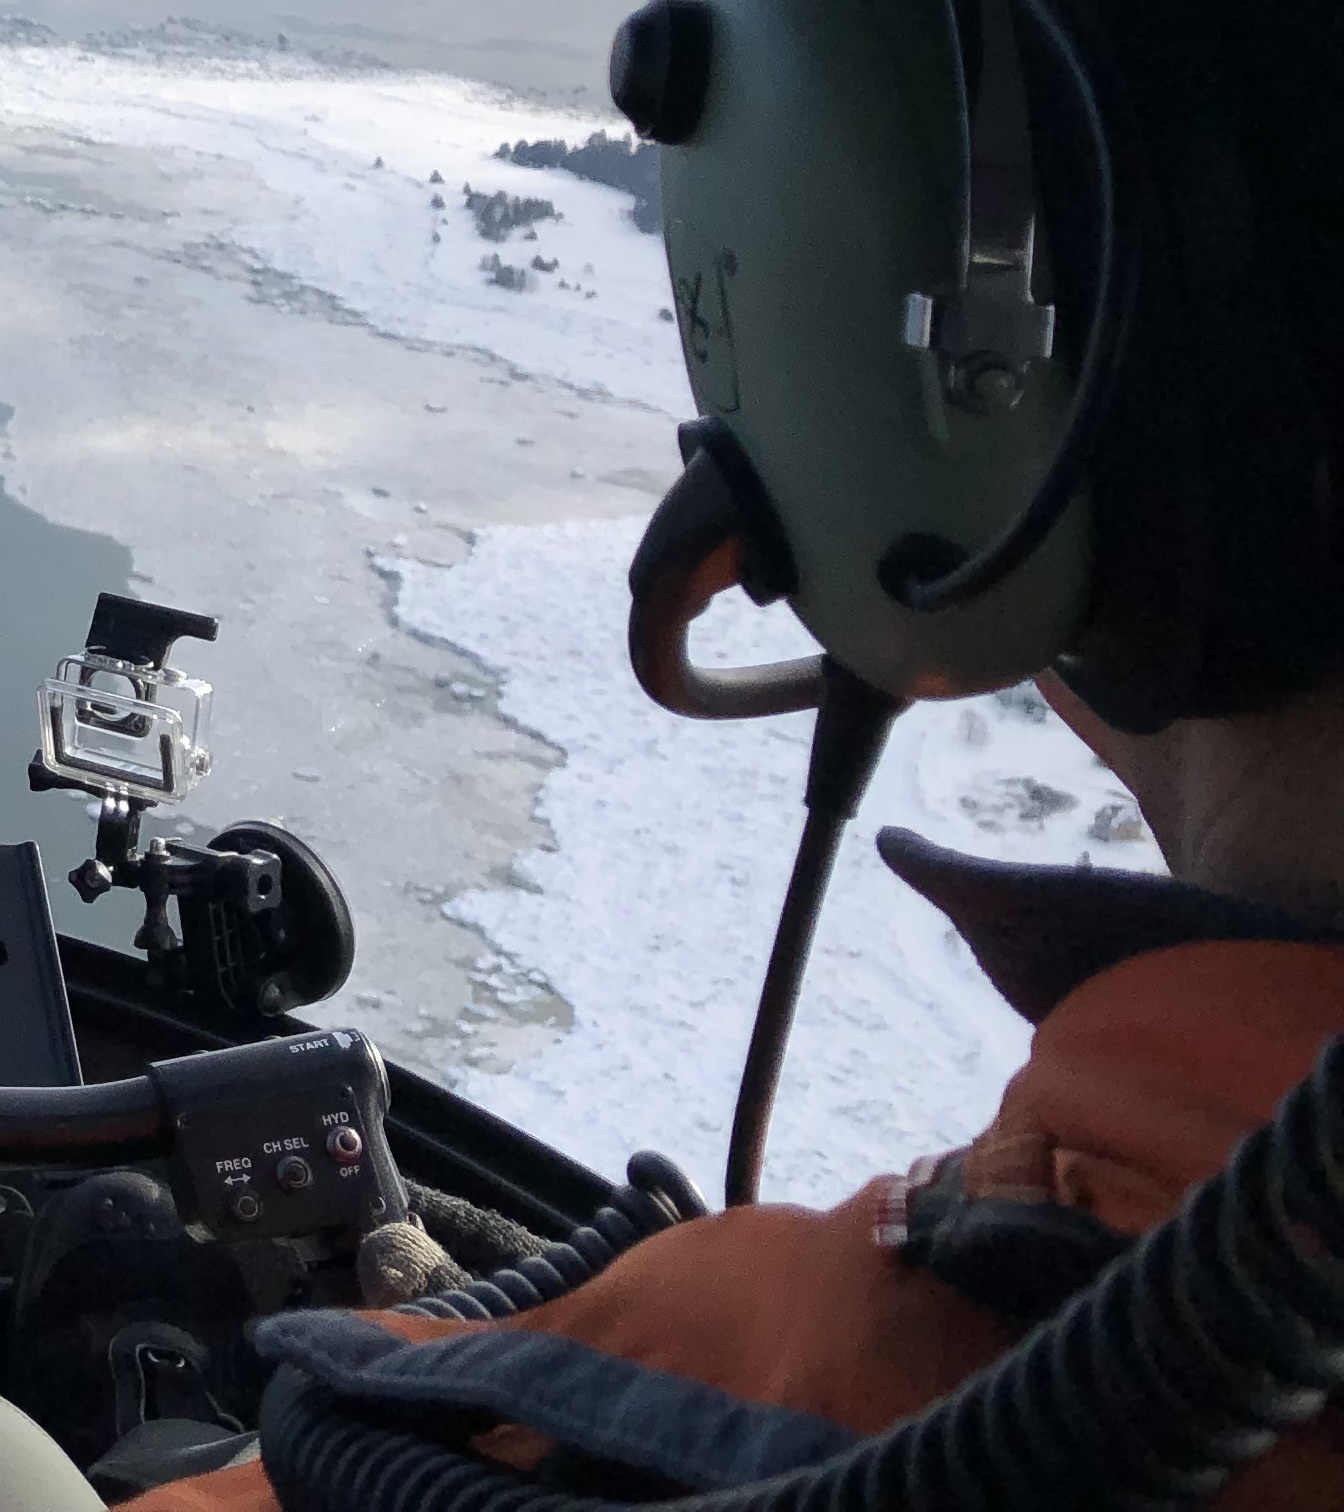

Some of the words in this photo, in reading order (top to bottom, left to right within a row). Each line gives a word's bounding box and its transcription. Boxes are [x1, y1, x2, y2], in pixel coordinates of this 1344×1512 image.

[288, 1038, 330, 1054] START
[322, 1111, 350, 1126] HYD
[262, 1142, 283, 1154] CH
[284, 1136, 310, 1150] SEL
[215, 1156, 253, 1173] FREQ
[338, 1165, 360, 1178] OFF
